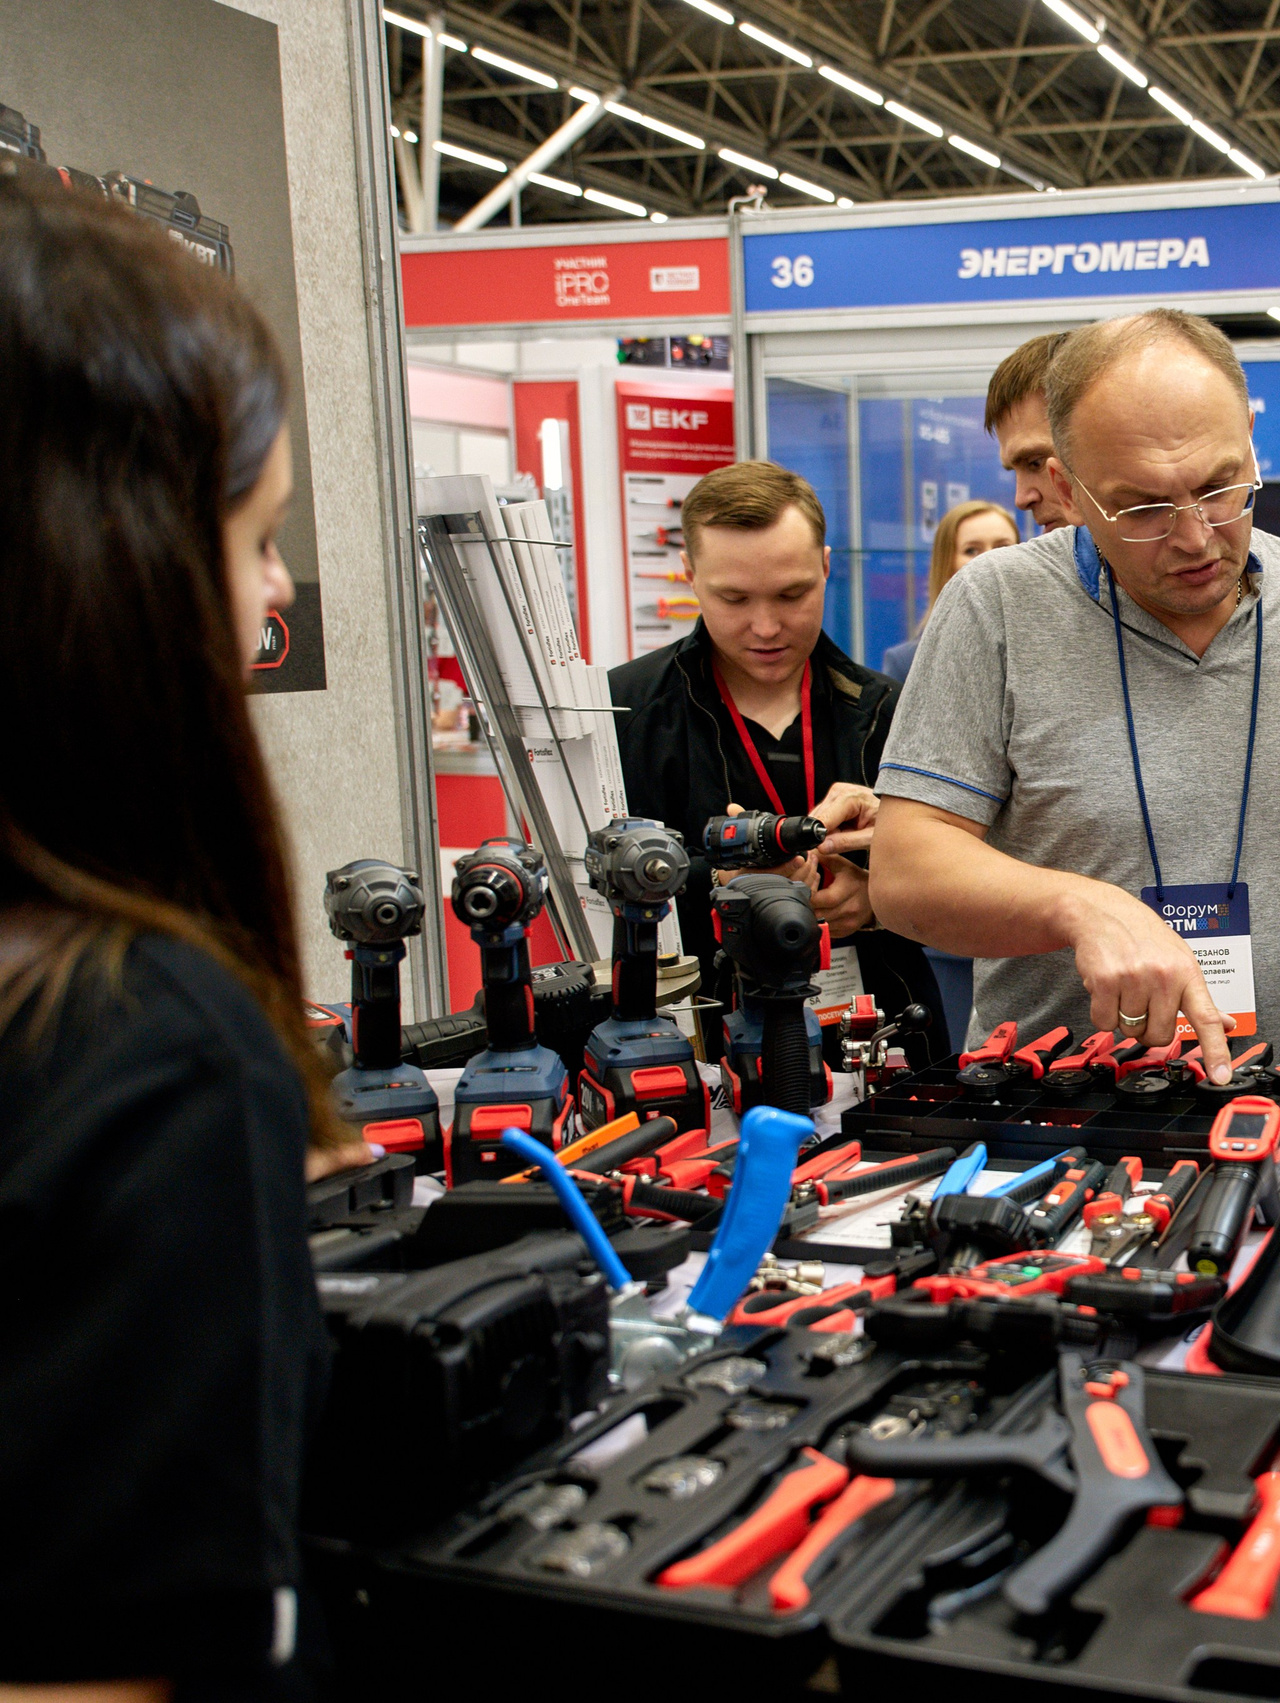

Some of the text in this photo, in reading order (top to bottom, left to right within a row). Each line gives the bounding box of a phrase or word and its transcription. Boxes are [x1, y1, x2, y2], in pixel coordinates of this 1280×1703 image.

[957, 237, 1211, 280] ЭНЕРГОМЕРА
[555, 270, 609, 296] iPRO
[771, 255, 814, 288] 36
[652, 407, 709, 431] EKF
[1162, 904, 1218, 918] Форум
[1165, 918, 1197, 932] ЭТМ
[819, 1009, 846, 1021] ПОСЕТИ
